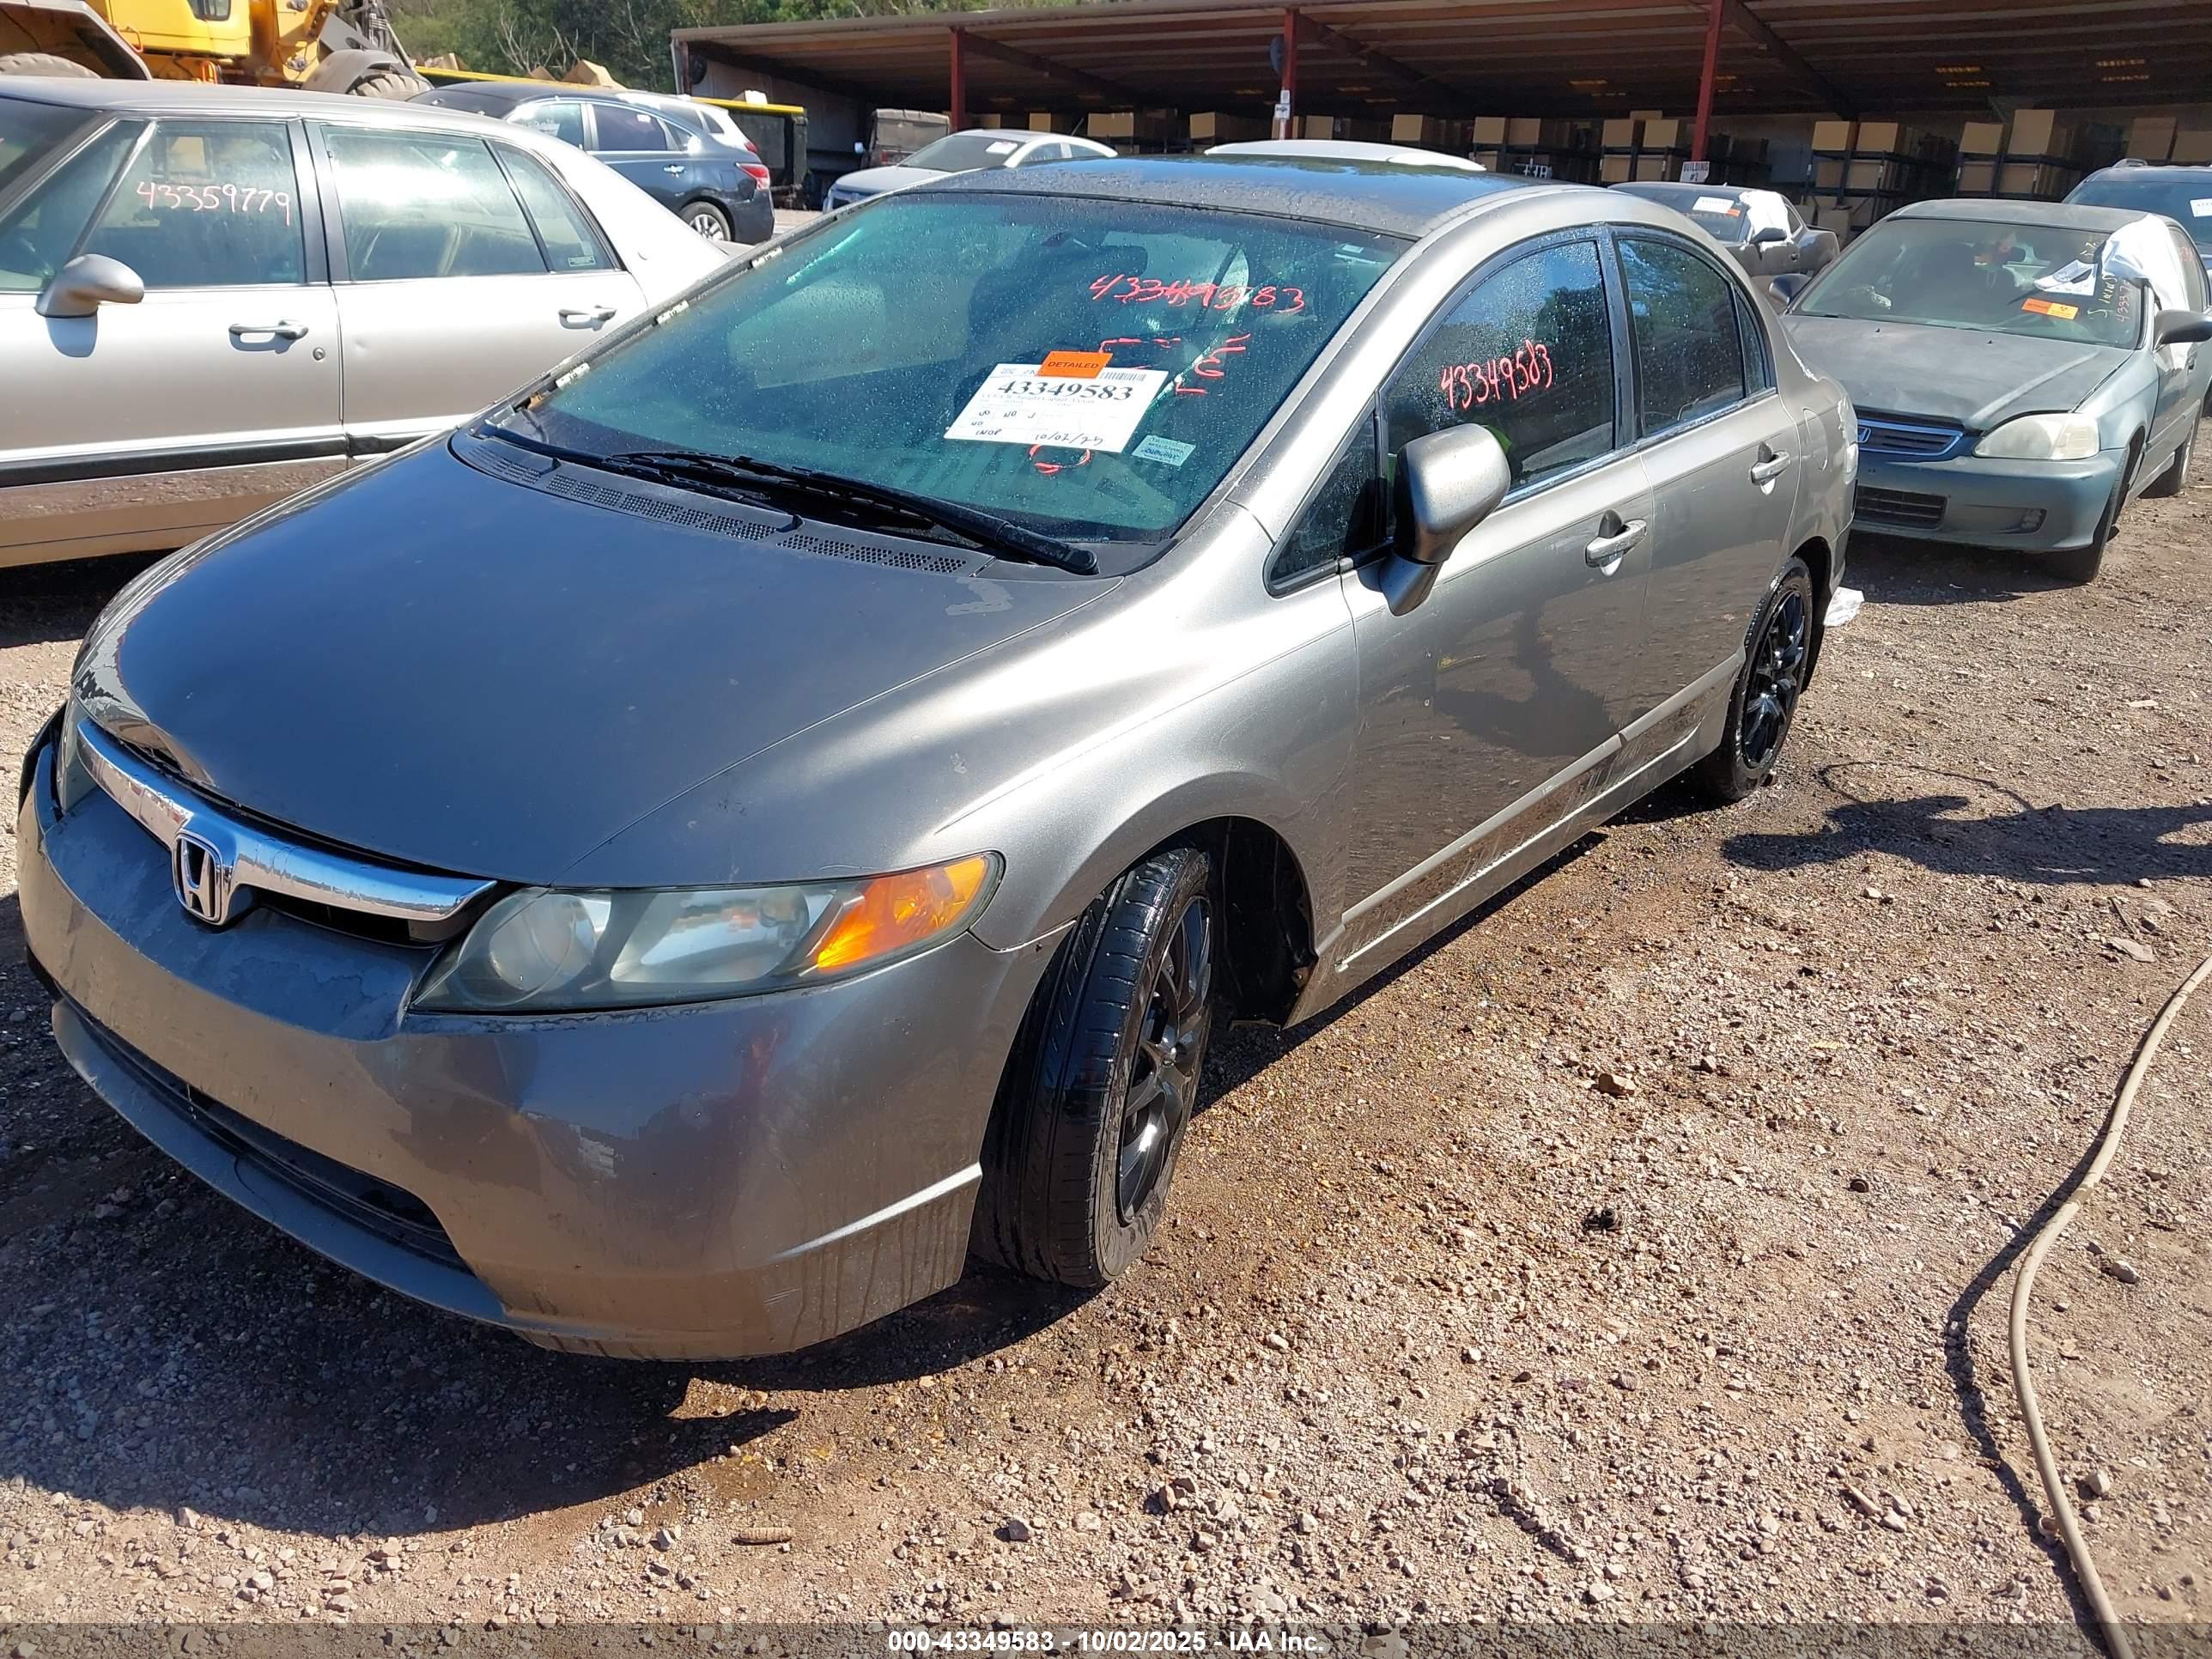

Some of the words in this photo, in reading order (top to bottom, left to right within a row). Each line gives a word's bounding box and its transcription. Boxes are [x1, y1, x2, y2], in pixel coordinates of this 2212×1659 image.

[137, 181, 290, 227] 43359779
[1048, 361, 1099, 369] DETAILED
[1441, 339, 1553, 409] 43349583
[998, 380, 1133, 401] 43349583
